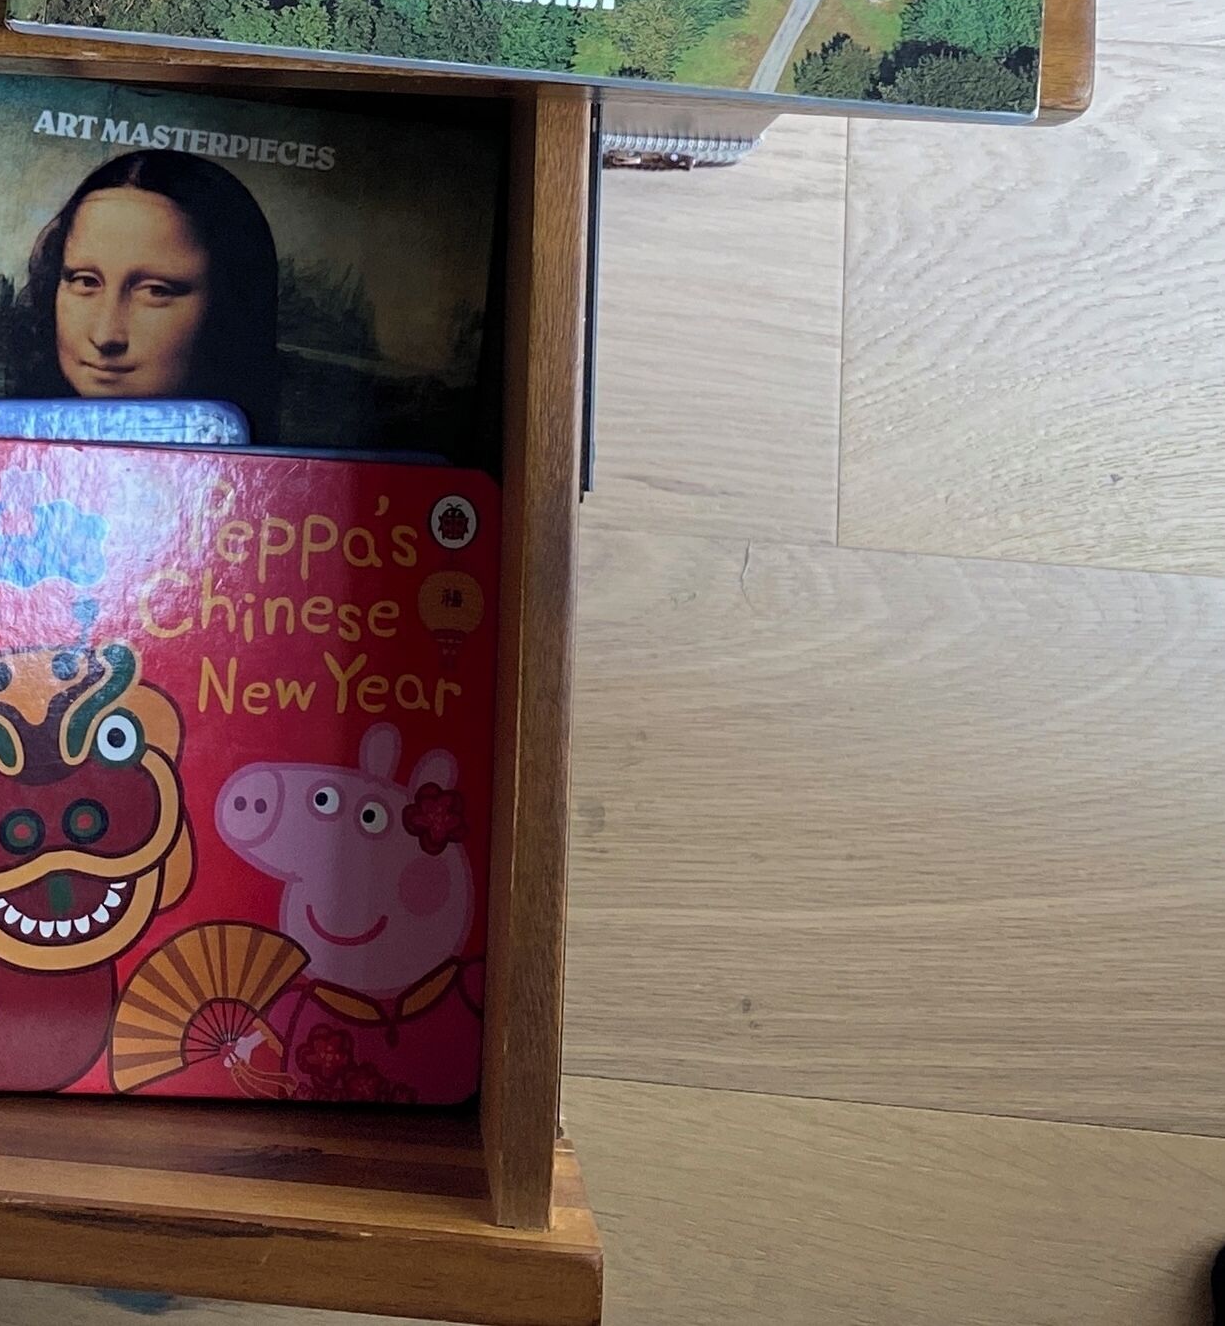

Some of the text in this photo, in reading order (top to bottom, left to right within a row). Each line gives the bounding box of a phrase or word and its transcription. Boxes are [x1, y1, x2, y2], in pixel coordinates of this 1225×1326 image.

[34, 109, 336, 172] ART MASTERPIECES
[192, 478, 419, 582] Peppa's
[137, 567, 401, 644] Chinese
[197, 650, 463, 717] New Year
